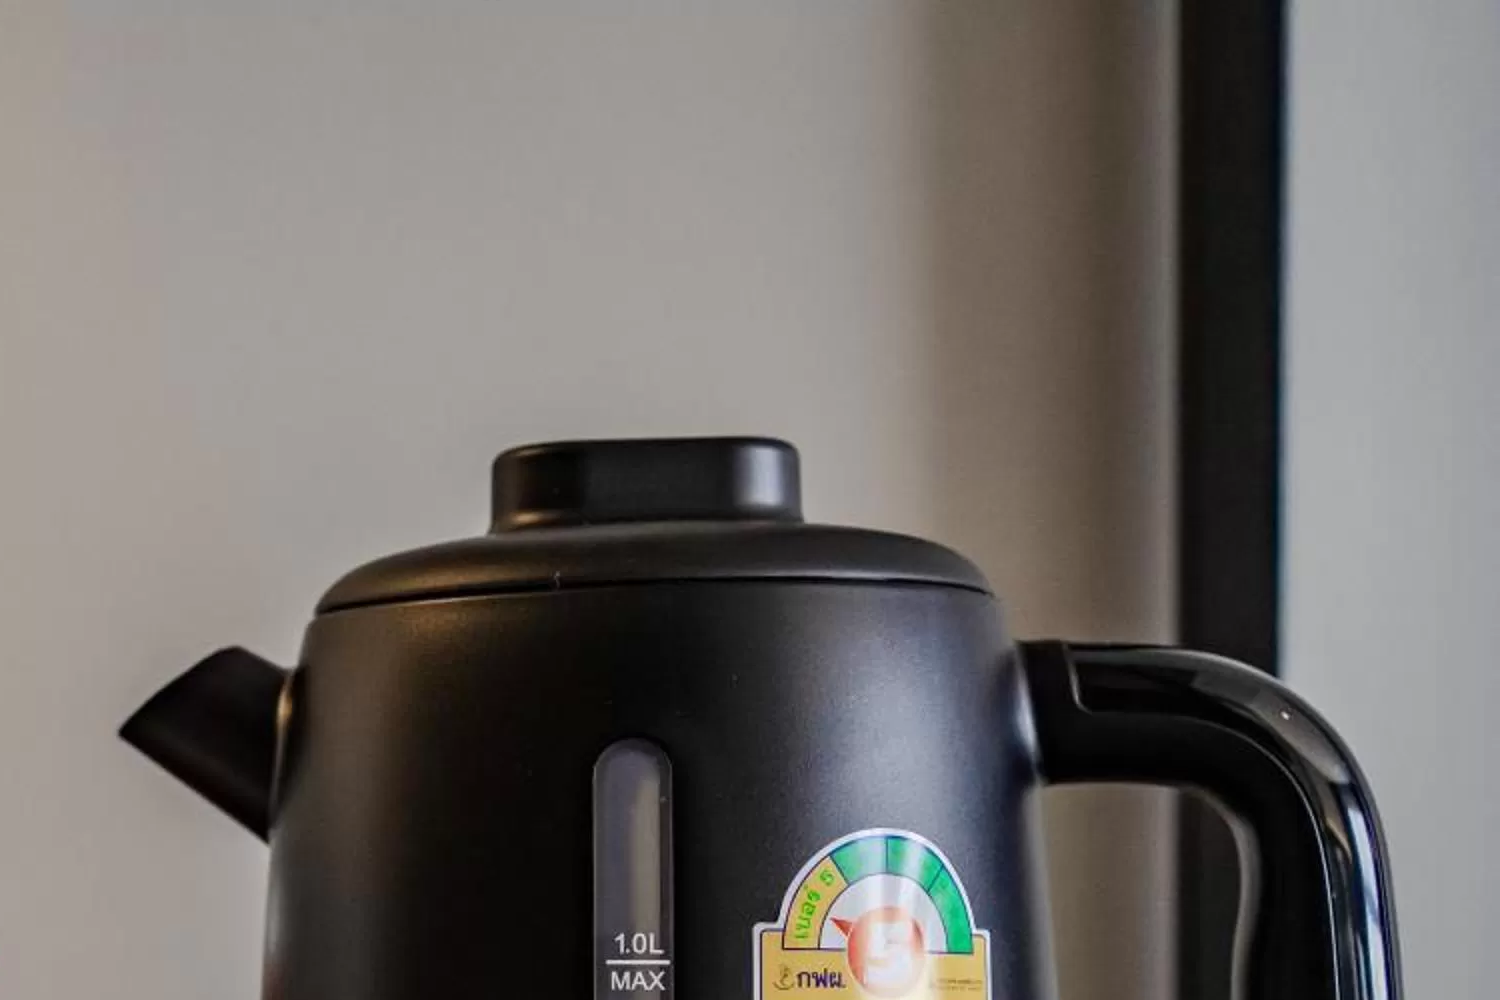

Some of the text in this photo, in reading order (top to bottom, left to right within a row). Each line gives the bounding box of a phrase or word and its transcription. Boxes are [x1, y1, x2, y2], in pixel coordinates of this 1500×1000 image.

[819, 868, 836, 887] 5
[614, 932, 665, 955] 1.0L
[610, 971, 665, 991] MAX
